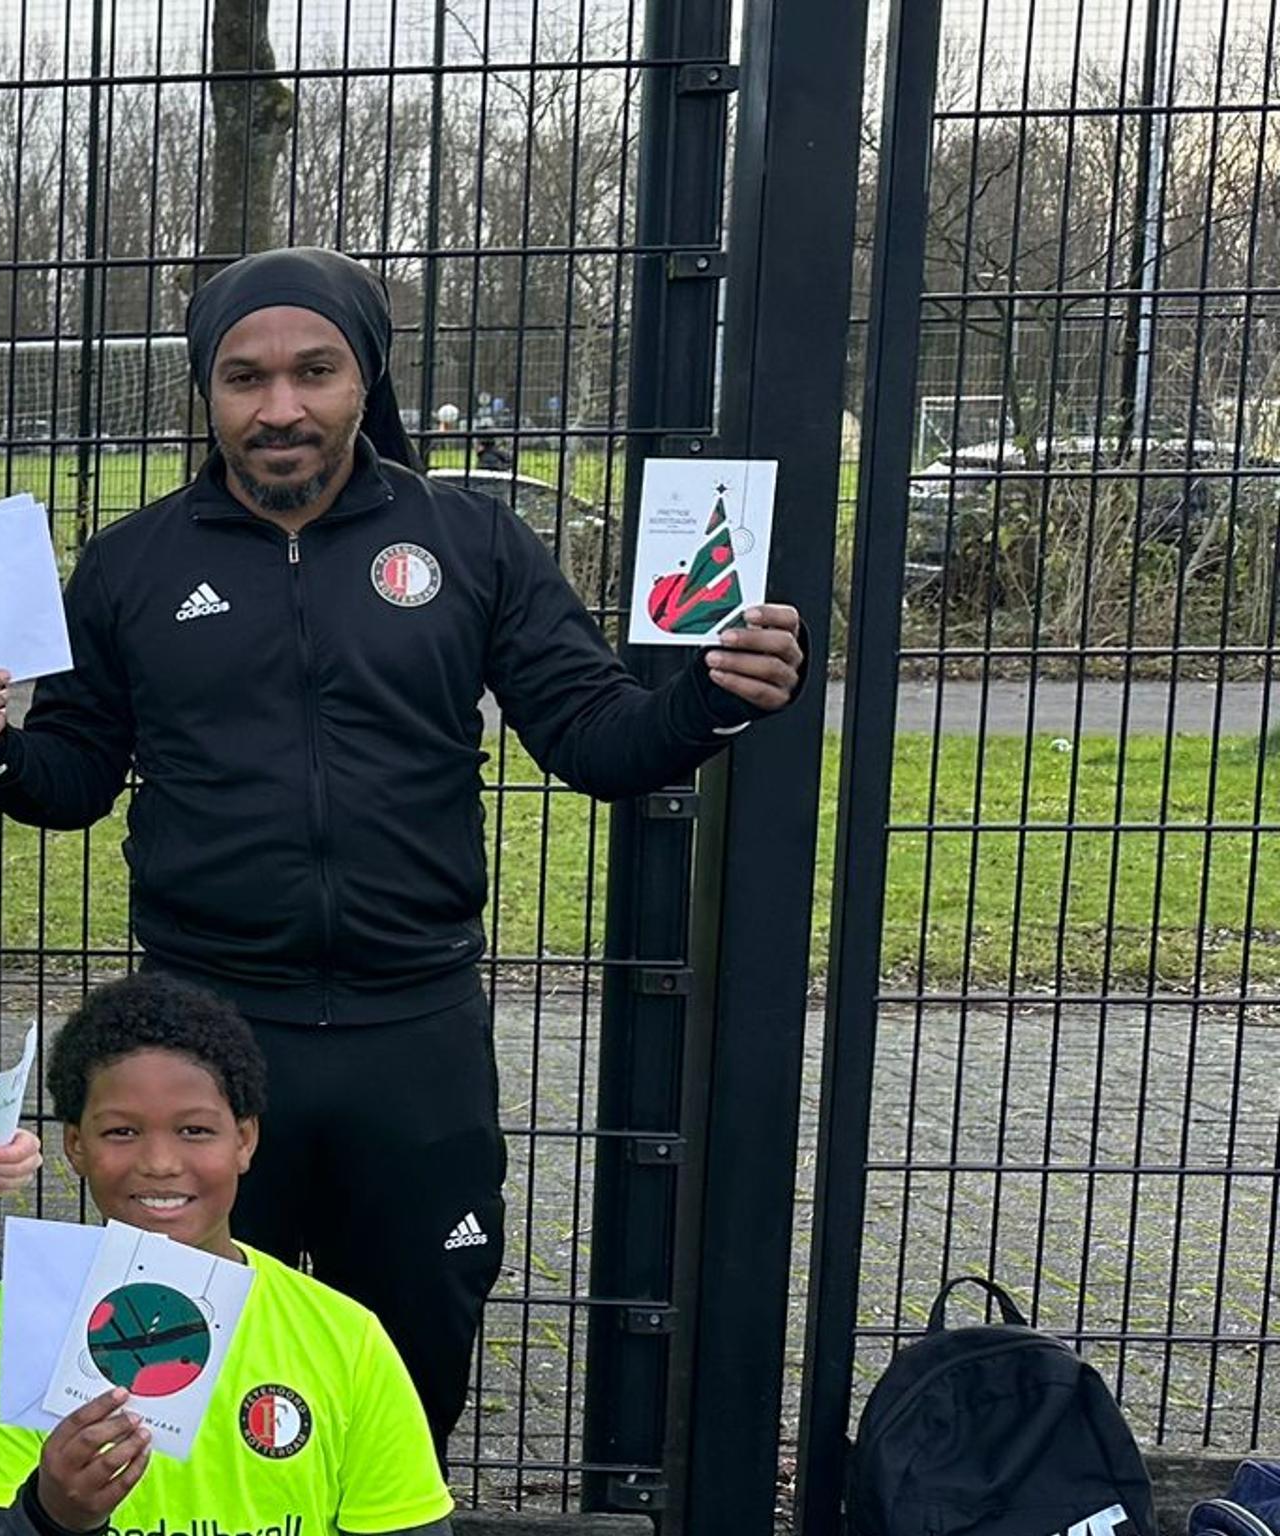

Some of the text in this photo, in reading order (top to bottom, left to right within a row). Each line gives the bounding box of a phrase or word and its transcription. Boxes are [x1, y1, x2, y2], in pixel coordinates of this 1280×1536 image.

[175, 600, 231, 621] adidas
[444, 1233, 488, 1250] adidas
[243, 1386, 308, 1414] FEYENOORD
